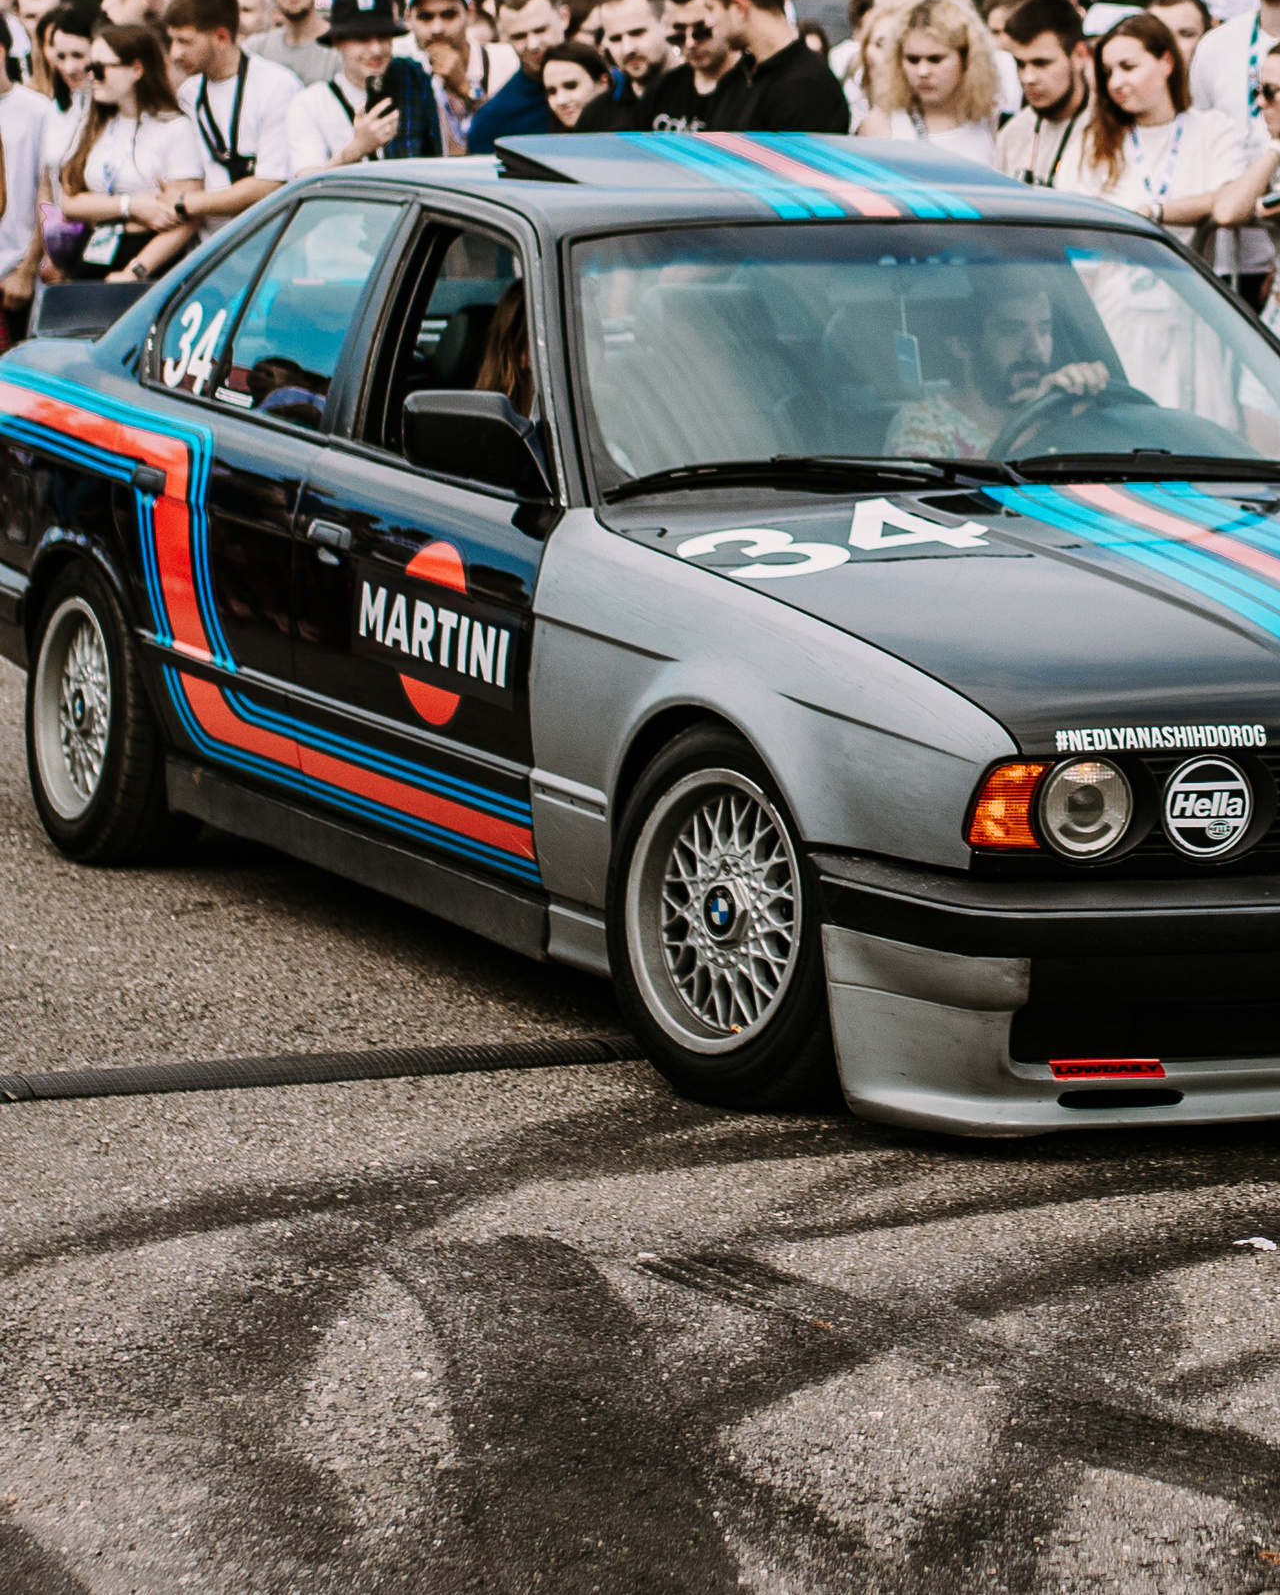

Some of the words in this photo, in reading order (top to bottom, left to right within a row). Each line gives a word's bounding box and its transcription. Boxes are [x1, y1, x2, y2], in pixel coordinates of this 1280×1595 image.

[163, 301, 227, 396] 34
[676, 497, 990, 579] 34
[359, 580, 510, 689] MARTINI
[1055, 724, 1267, 752] #NEDLYANASHIHDOROG
[1172, 791, 1244, 817] Hella
[1055, 1064, 1159, 1075] LOWDAILY
